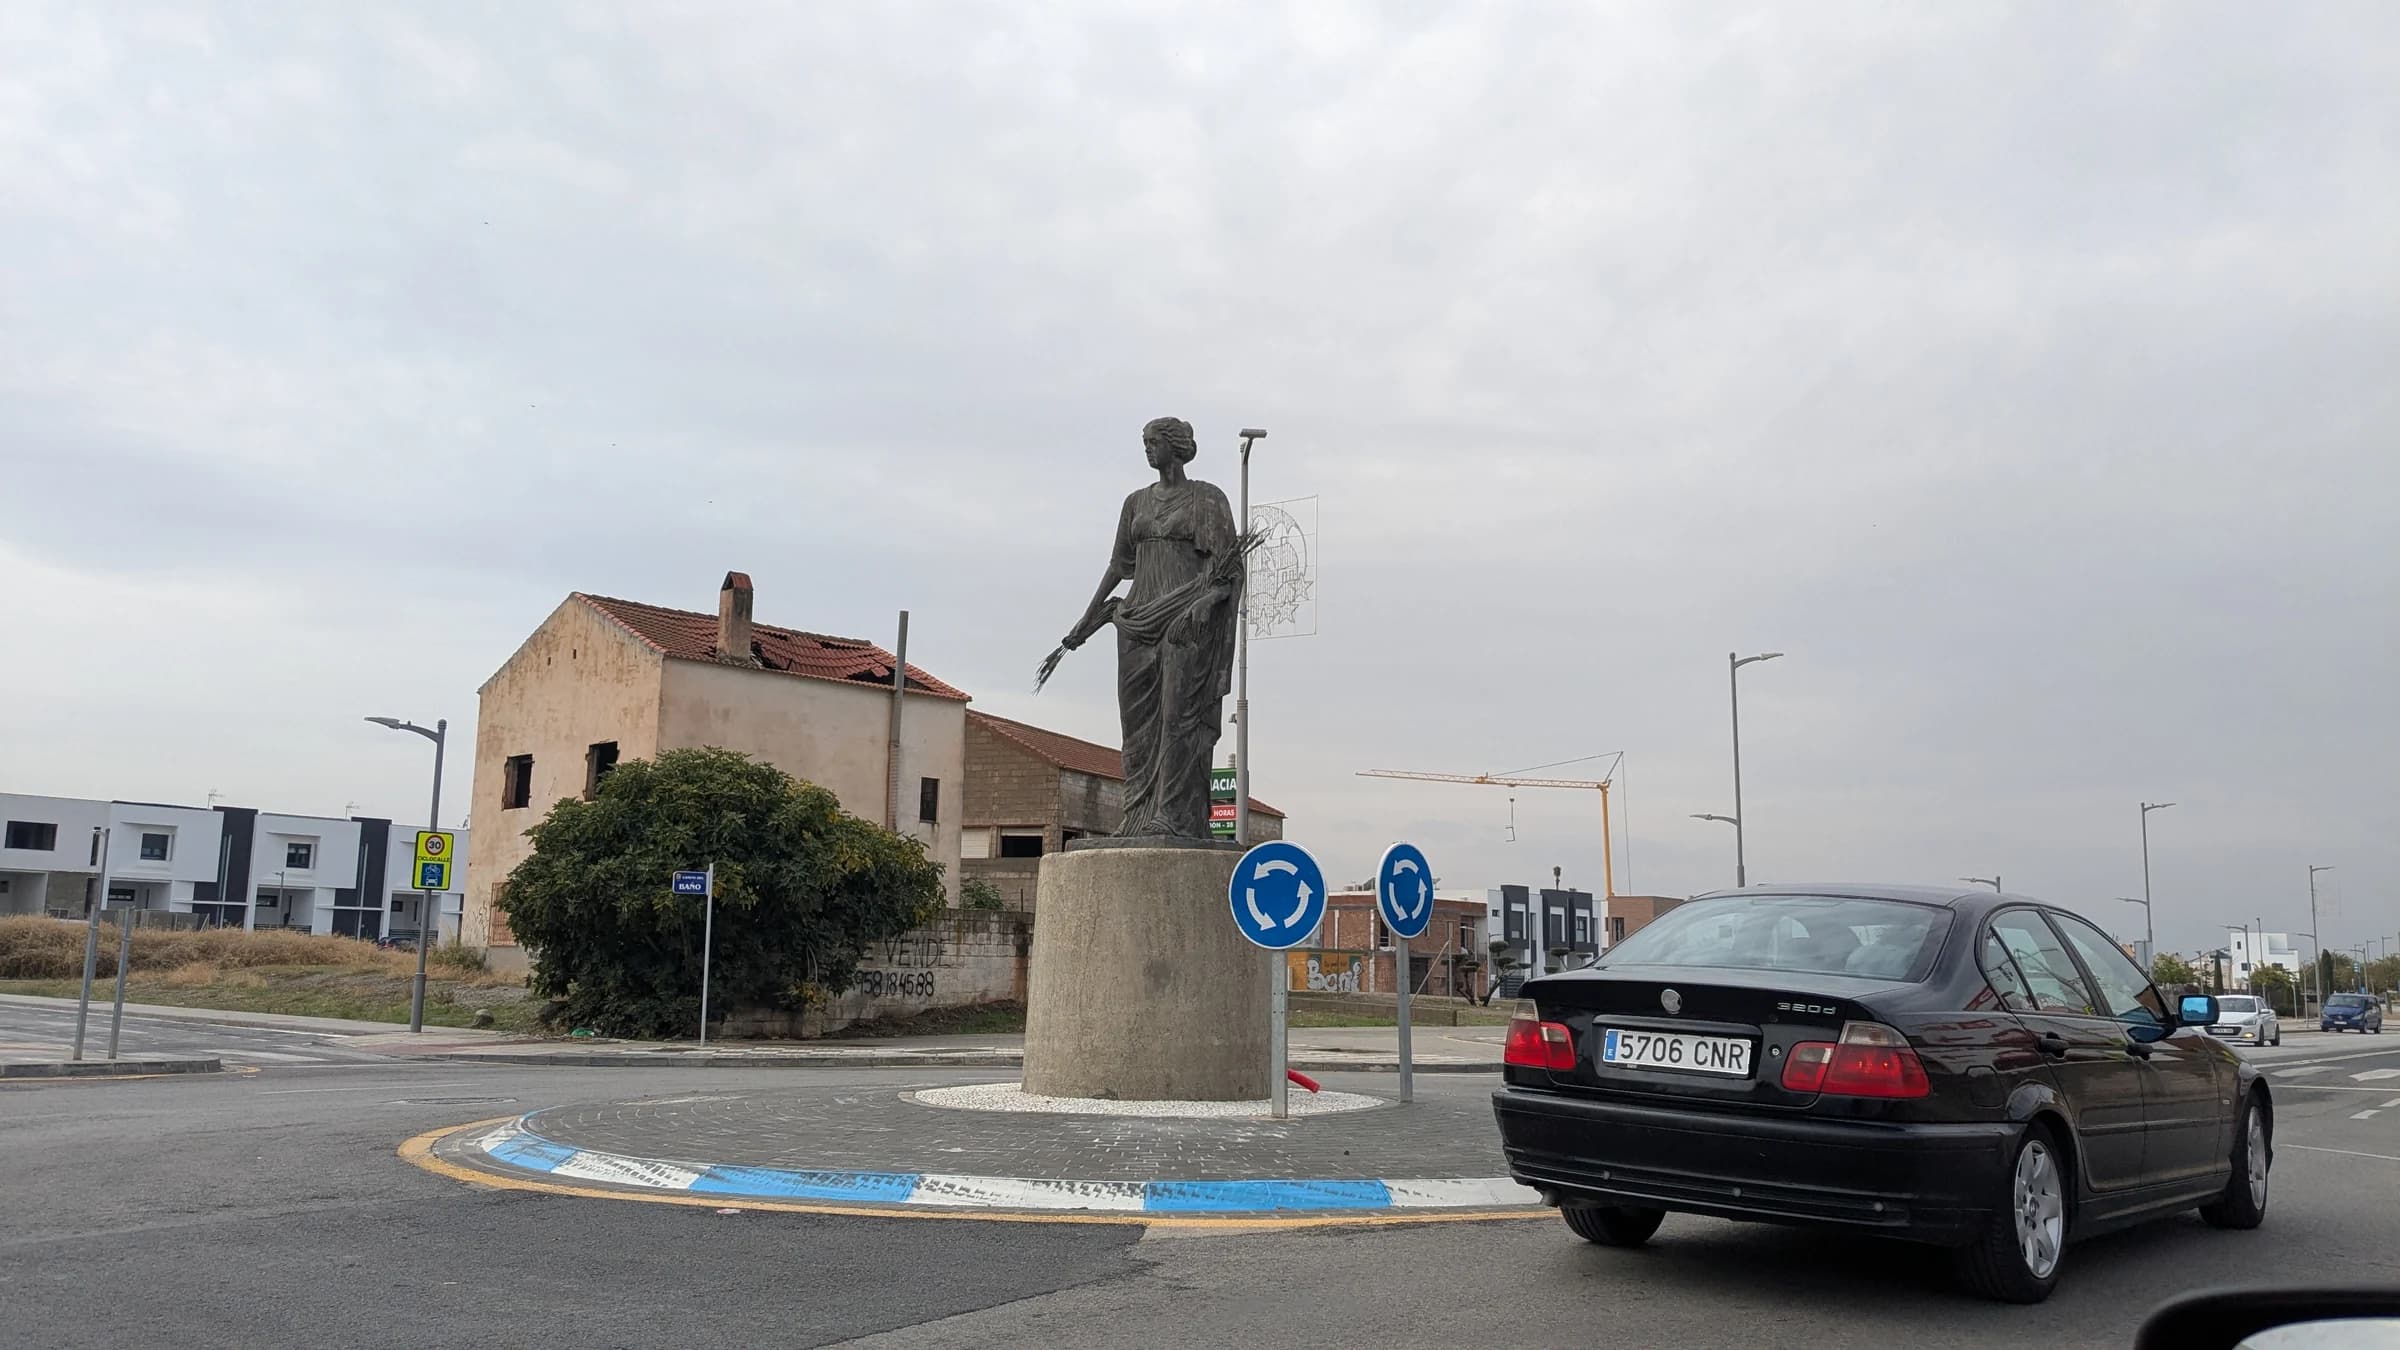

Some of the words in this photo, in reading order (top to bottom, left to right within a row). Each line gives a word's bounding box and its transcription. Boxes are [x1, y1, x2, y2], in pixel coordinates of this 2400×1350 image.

[429, 841, 441, 849] 30
[679, 882, 701, 890] BAÑO
[884, 937, 951, 967] VENDE
[1776, 1002, 1837, 1015] 320d
[1621, 1035, 1683, 1063] 5706
[1694, 1040, 1744, 1070] CNR
